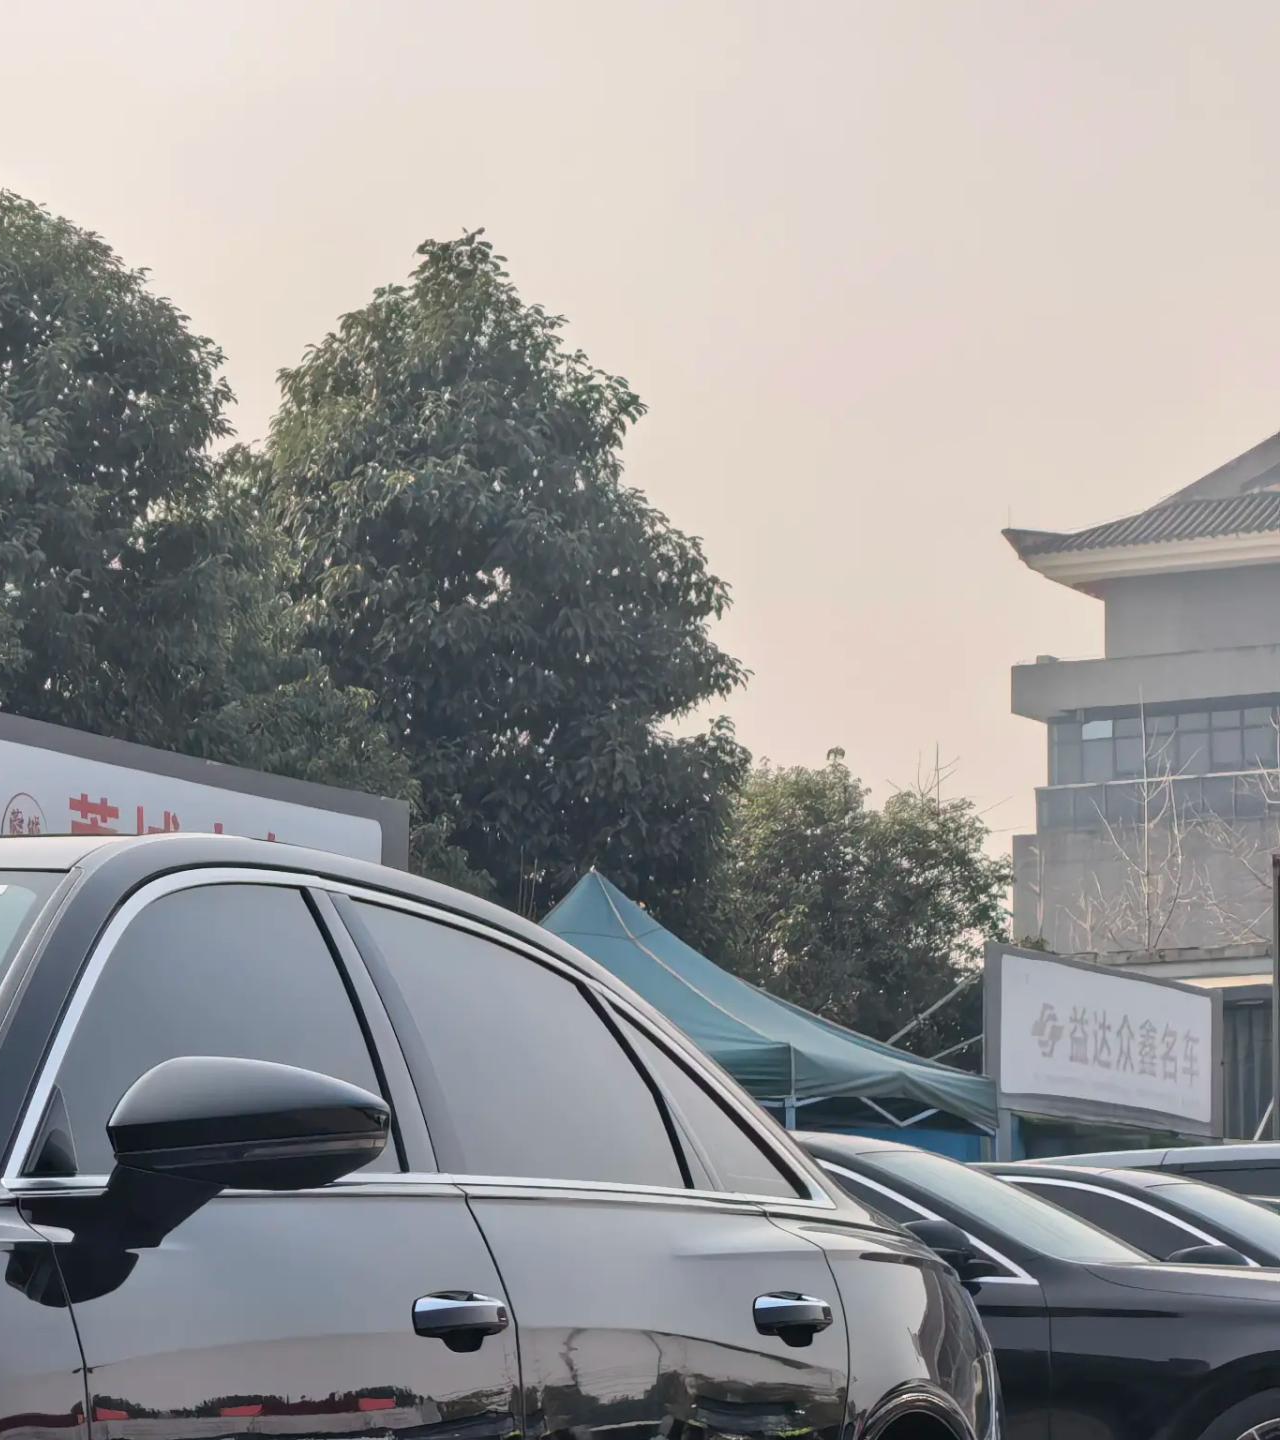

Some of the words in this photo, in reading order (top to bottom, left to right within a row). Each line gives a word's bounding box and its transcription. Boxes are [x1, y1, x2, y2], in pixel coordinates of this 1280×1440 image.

[1068, 1004, 1201, 1088] 益达众鑫名车
